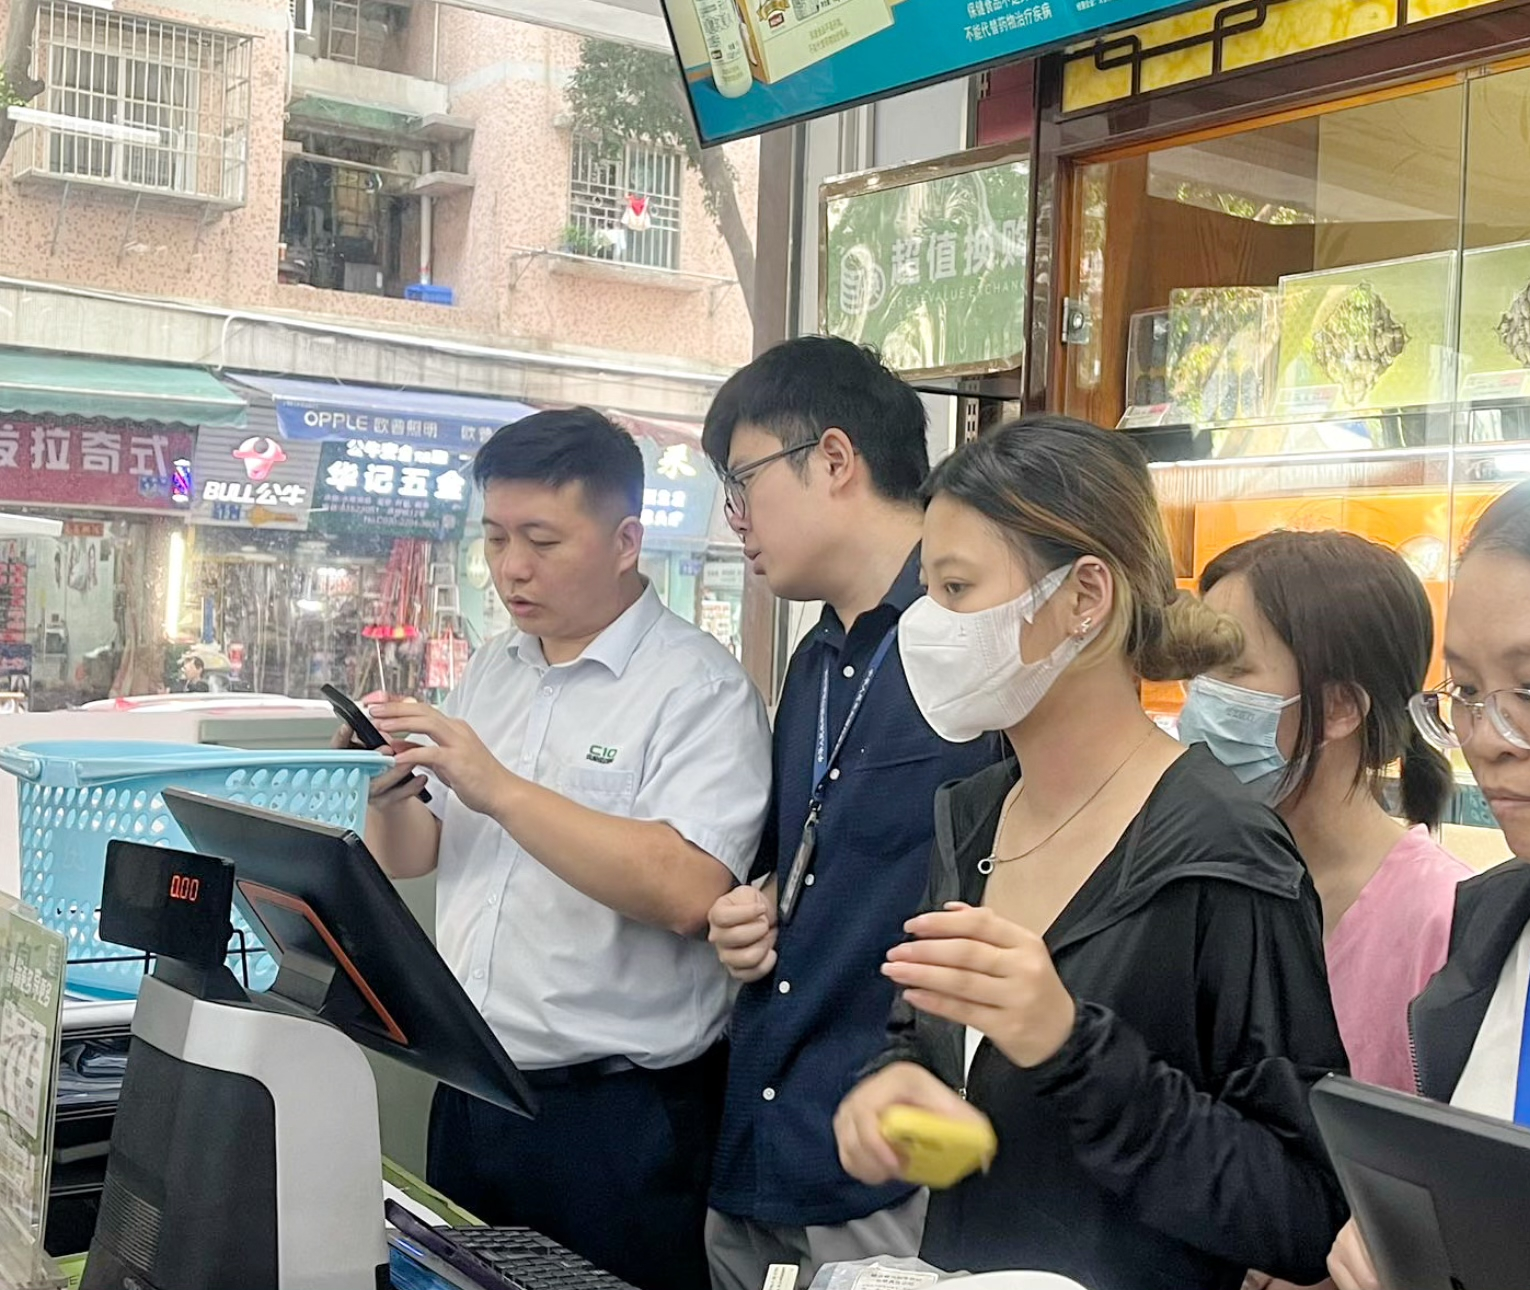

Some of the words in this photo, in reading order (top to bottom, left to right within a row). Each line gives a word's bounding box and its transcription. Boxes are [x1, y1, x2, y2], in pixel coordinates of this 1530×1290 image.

[304, 410, 368, 430] OPPLE
[325, 460, 467, 501] 华记五金
